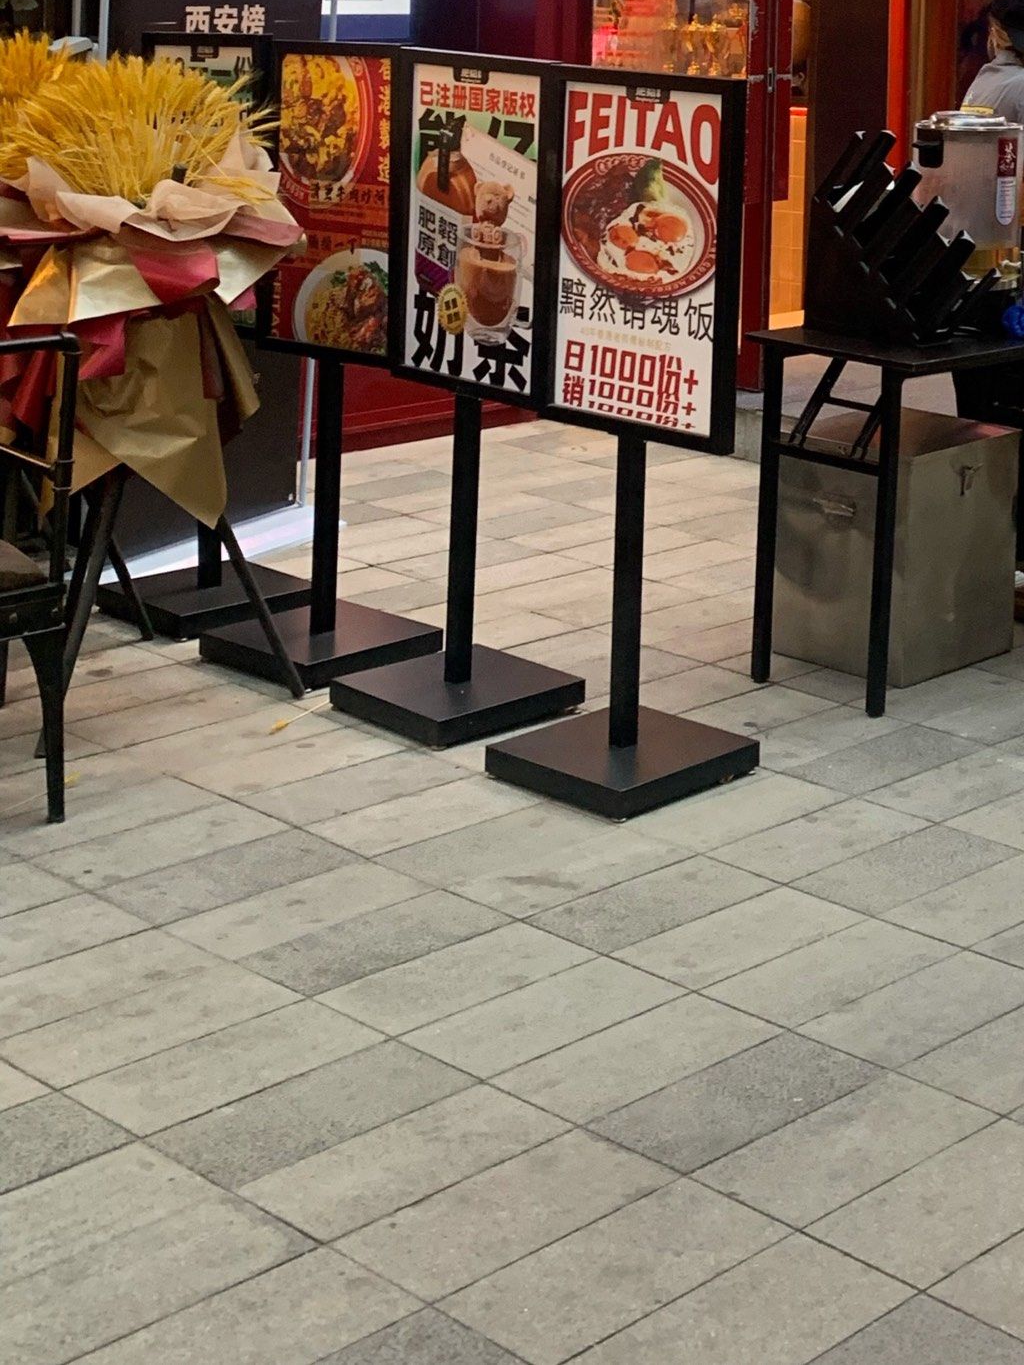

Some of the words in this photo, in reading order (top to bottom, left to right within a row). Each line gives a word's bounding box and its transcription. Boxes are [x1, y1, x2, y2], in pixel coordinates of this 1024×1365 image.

[185, 4, 266, 34] 西安榜
[420, 81, 536, 119] 已注册国家版权
[565, 90, 722, 185] FEITAO
